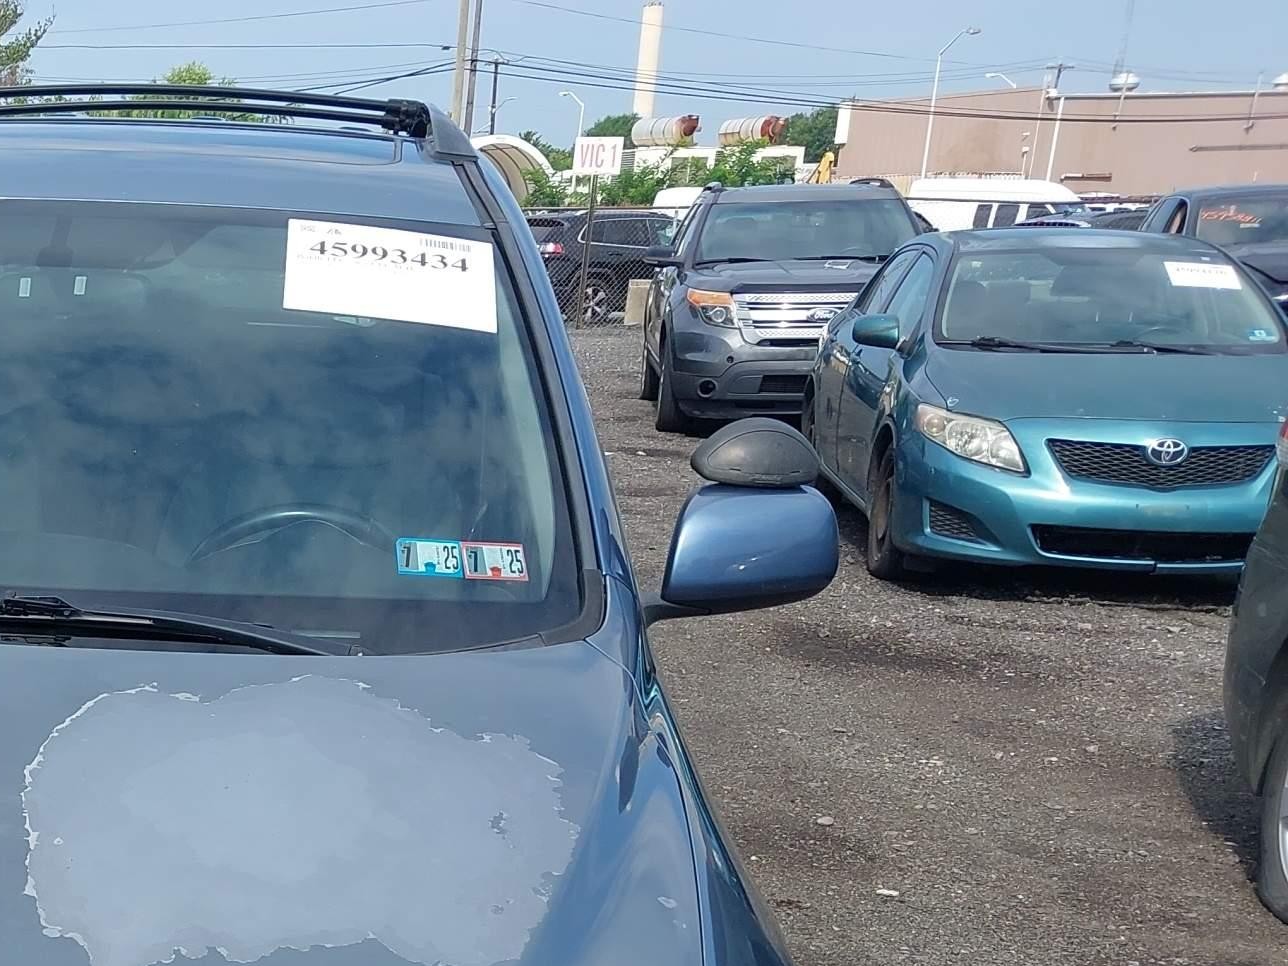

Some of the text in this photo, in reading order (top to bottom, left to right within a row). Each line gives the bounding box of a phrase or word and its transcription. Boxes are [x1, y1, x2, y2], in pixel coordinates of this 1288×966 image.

[580, 143, 617, 168] VIC 1
[309, 239, 470, 273] 45993434
[402, 546, 411, 568] 7
[443, 545, 459, 570] 25
[468, 550, 478, 573] 7
[506, 549, 524, 574] 25
